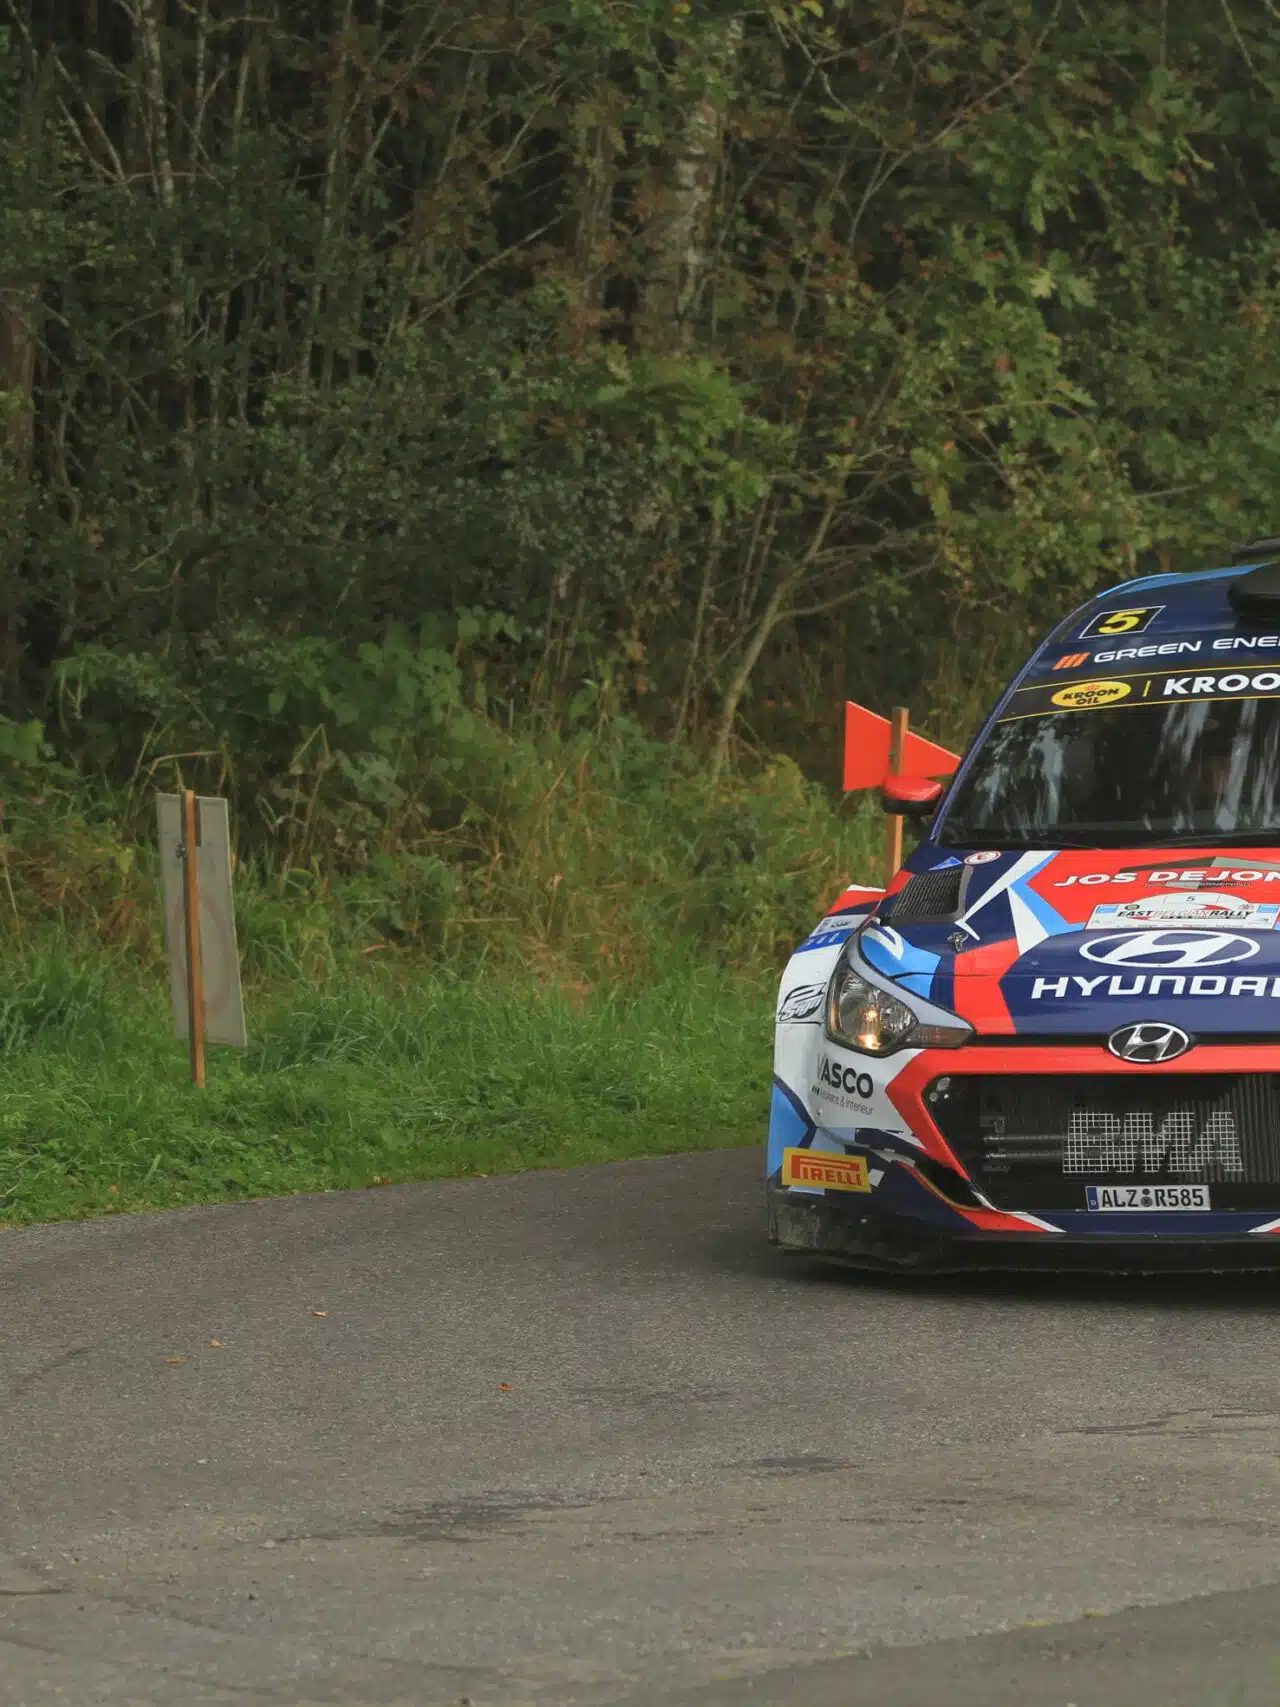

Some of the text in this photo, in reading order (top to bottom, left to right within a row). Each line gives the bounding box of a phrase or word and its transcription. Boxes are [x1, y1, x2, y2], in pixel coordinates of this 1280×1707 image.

[1098, 609, 1147, 634] 5
[1094, 640, 1202, 663] GREEN
[1062, 686, 1120, 700] KROON
[1075, 696, 1100, 705] OIL
[1053, 872, 1139, 887] JOS
[817, 1053, 874, 1099] VASCO
[1063, 1112, 1244, 1174] BMA
[791, 1154, 862, 1185] PIRELLI
[1101, 1188, 1205, 1208] ALZ R585
